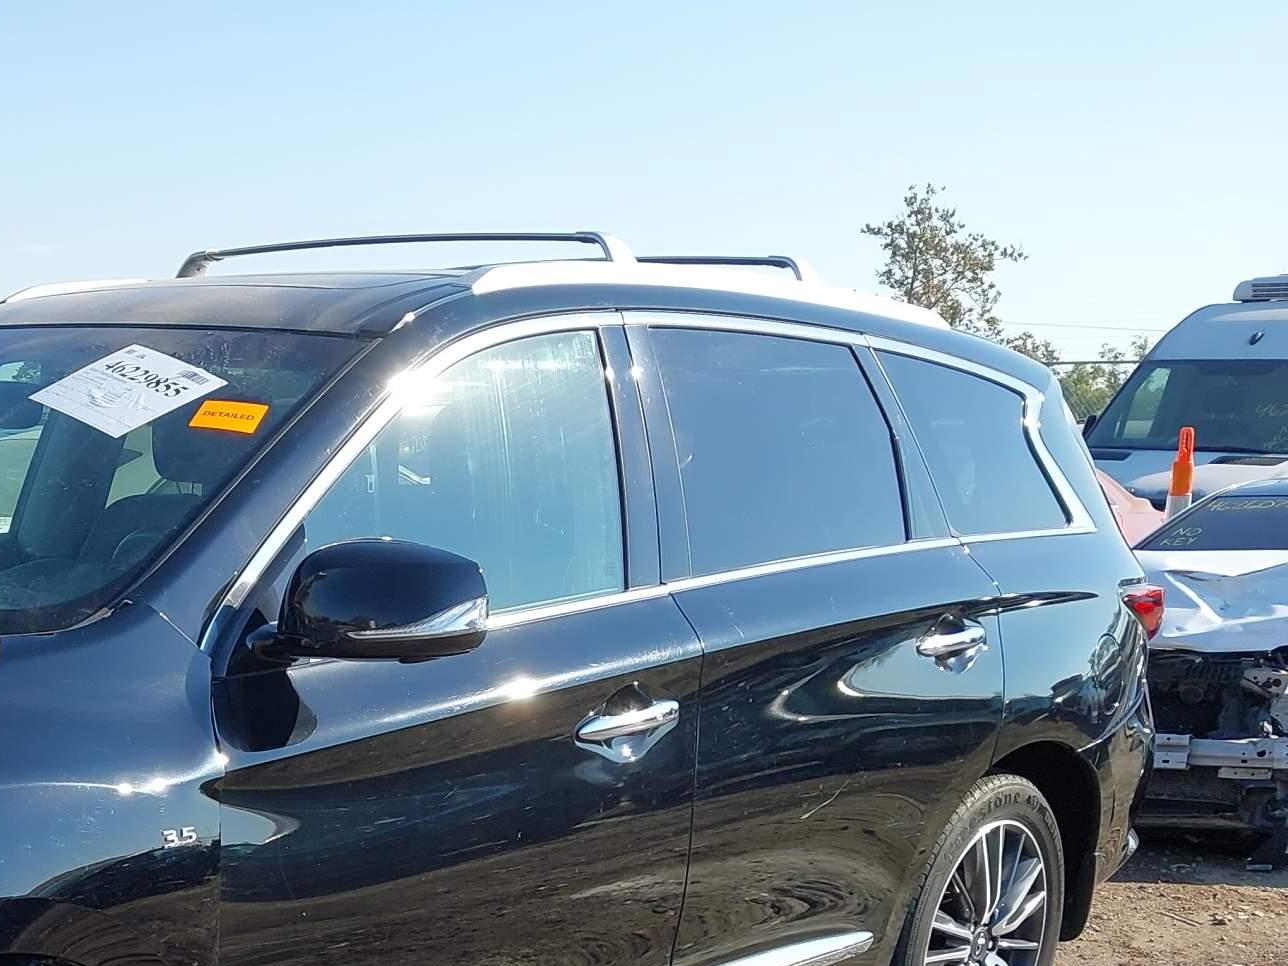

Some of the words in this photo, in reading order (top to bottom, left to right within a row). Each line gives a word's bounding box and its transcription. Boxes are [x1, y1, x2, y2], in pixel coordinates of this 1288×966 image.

[104, 360, 190, 398] 46229855
[203, 409, 255, 421] DETAILED
[1171, 527, 1203, 537] NO
[1160, 537, 1200, 546] KEY
